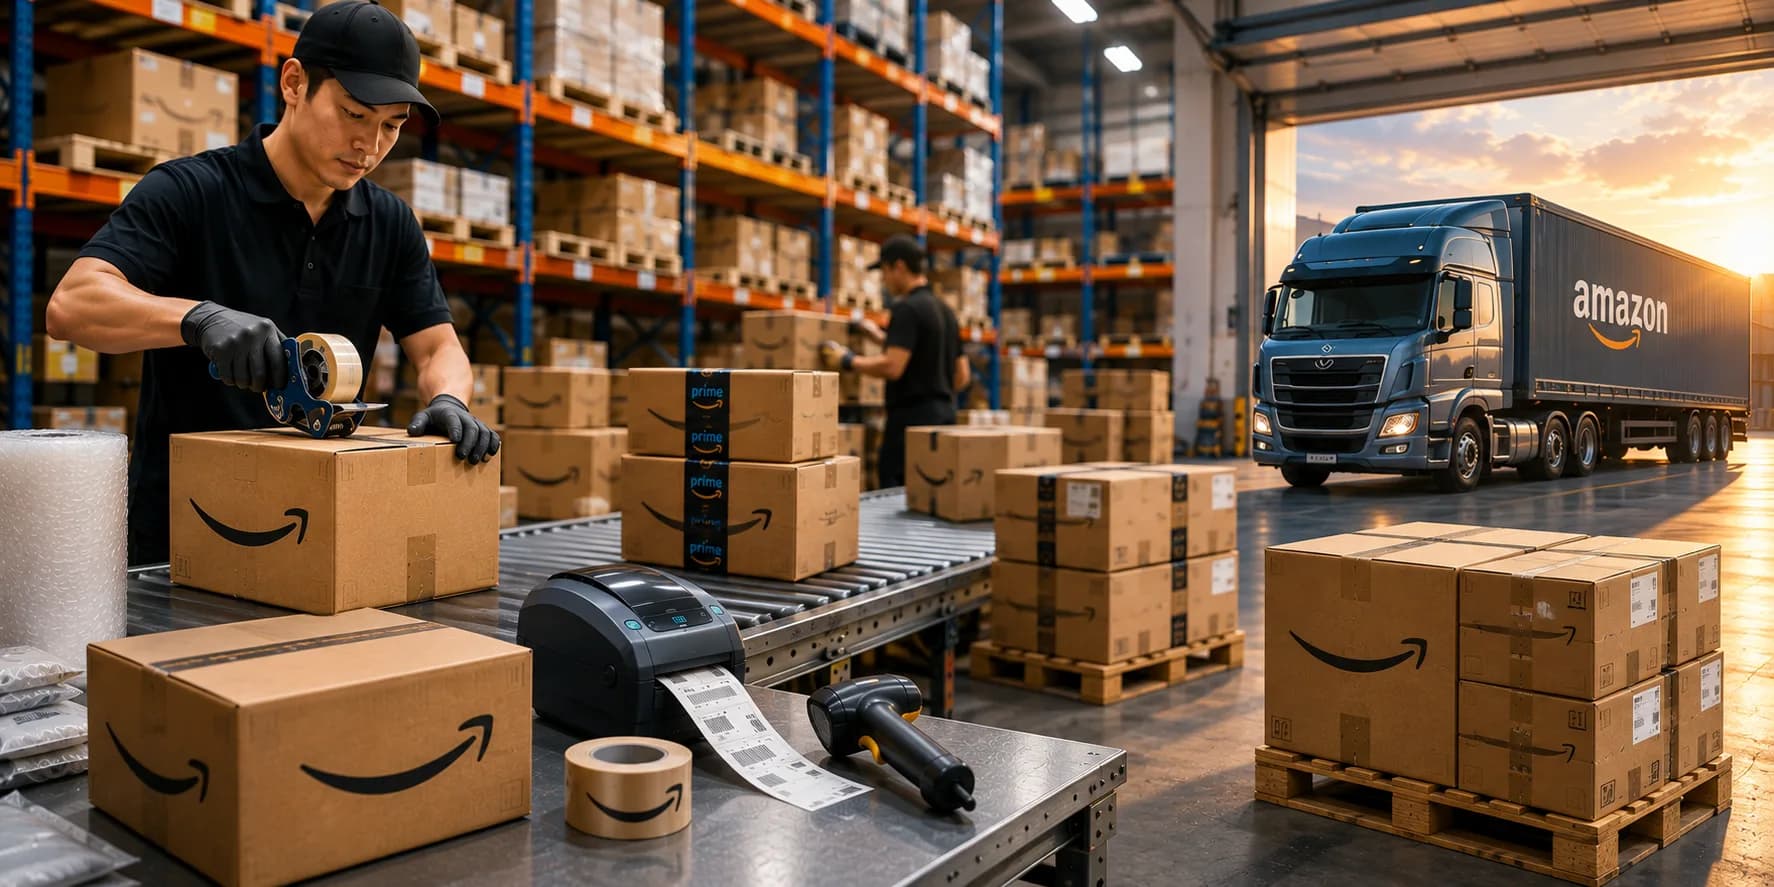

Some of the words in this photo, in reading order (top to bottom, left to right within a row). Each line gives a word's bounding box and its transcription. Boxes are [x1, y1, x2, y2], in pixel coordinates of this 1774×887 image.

[1573, 279, 1668, 334] amazon
[691, 384, 724, 399] prime
[691, 429, 723, 443] prime
[690, 475, 723, 488] prime
[689, 540, 722, 556] prime
